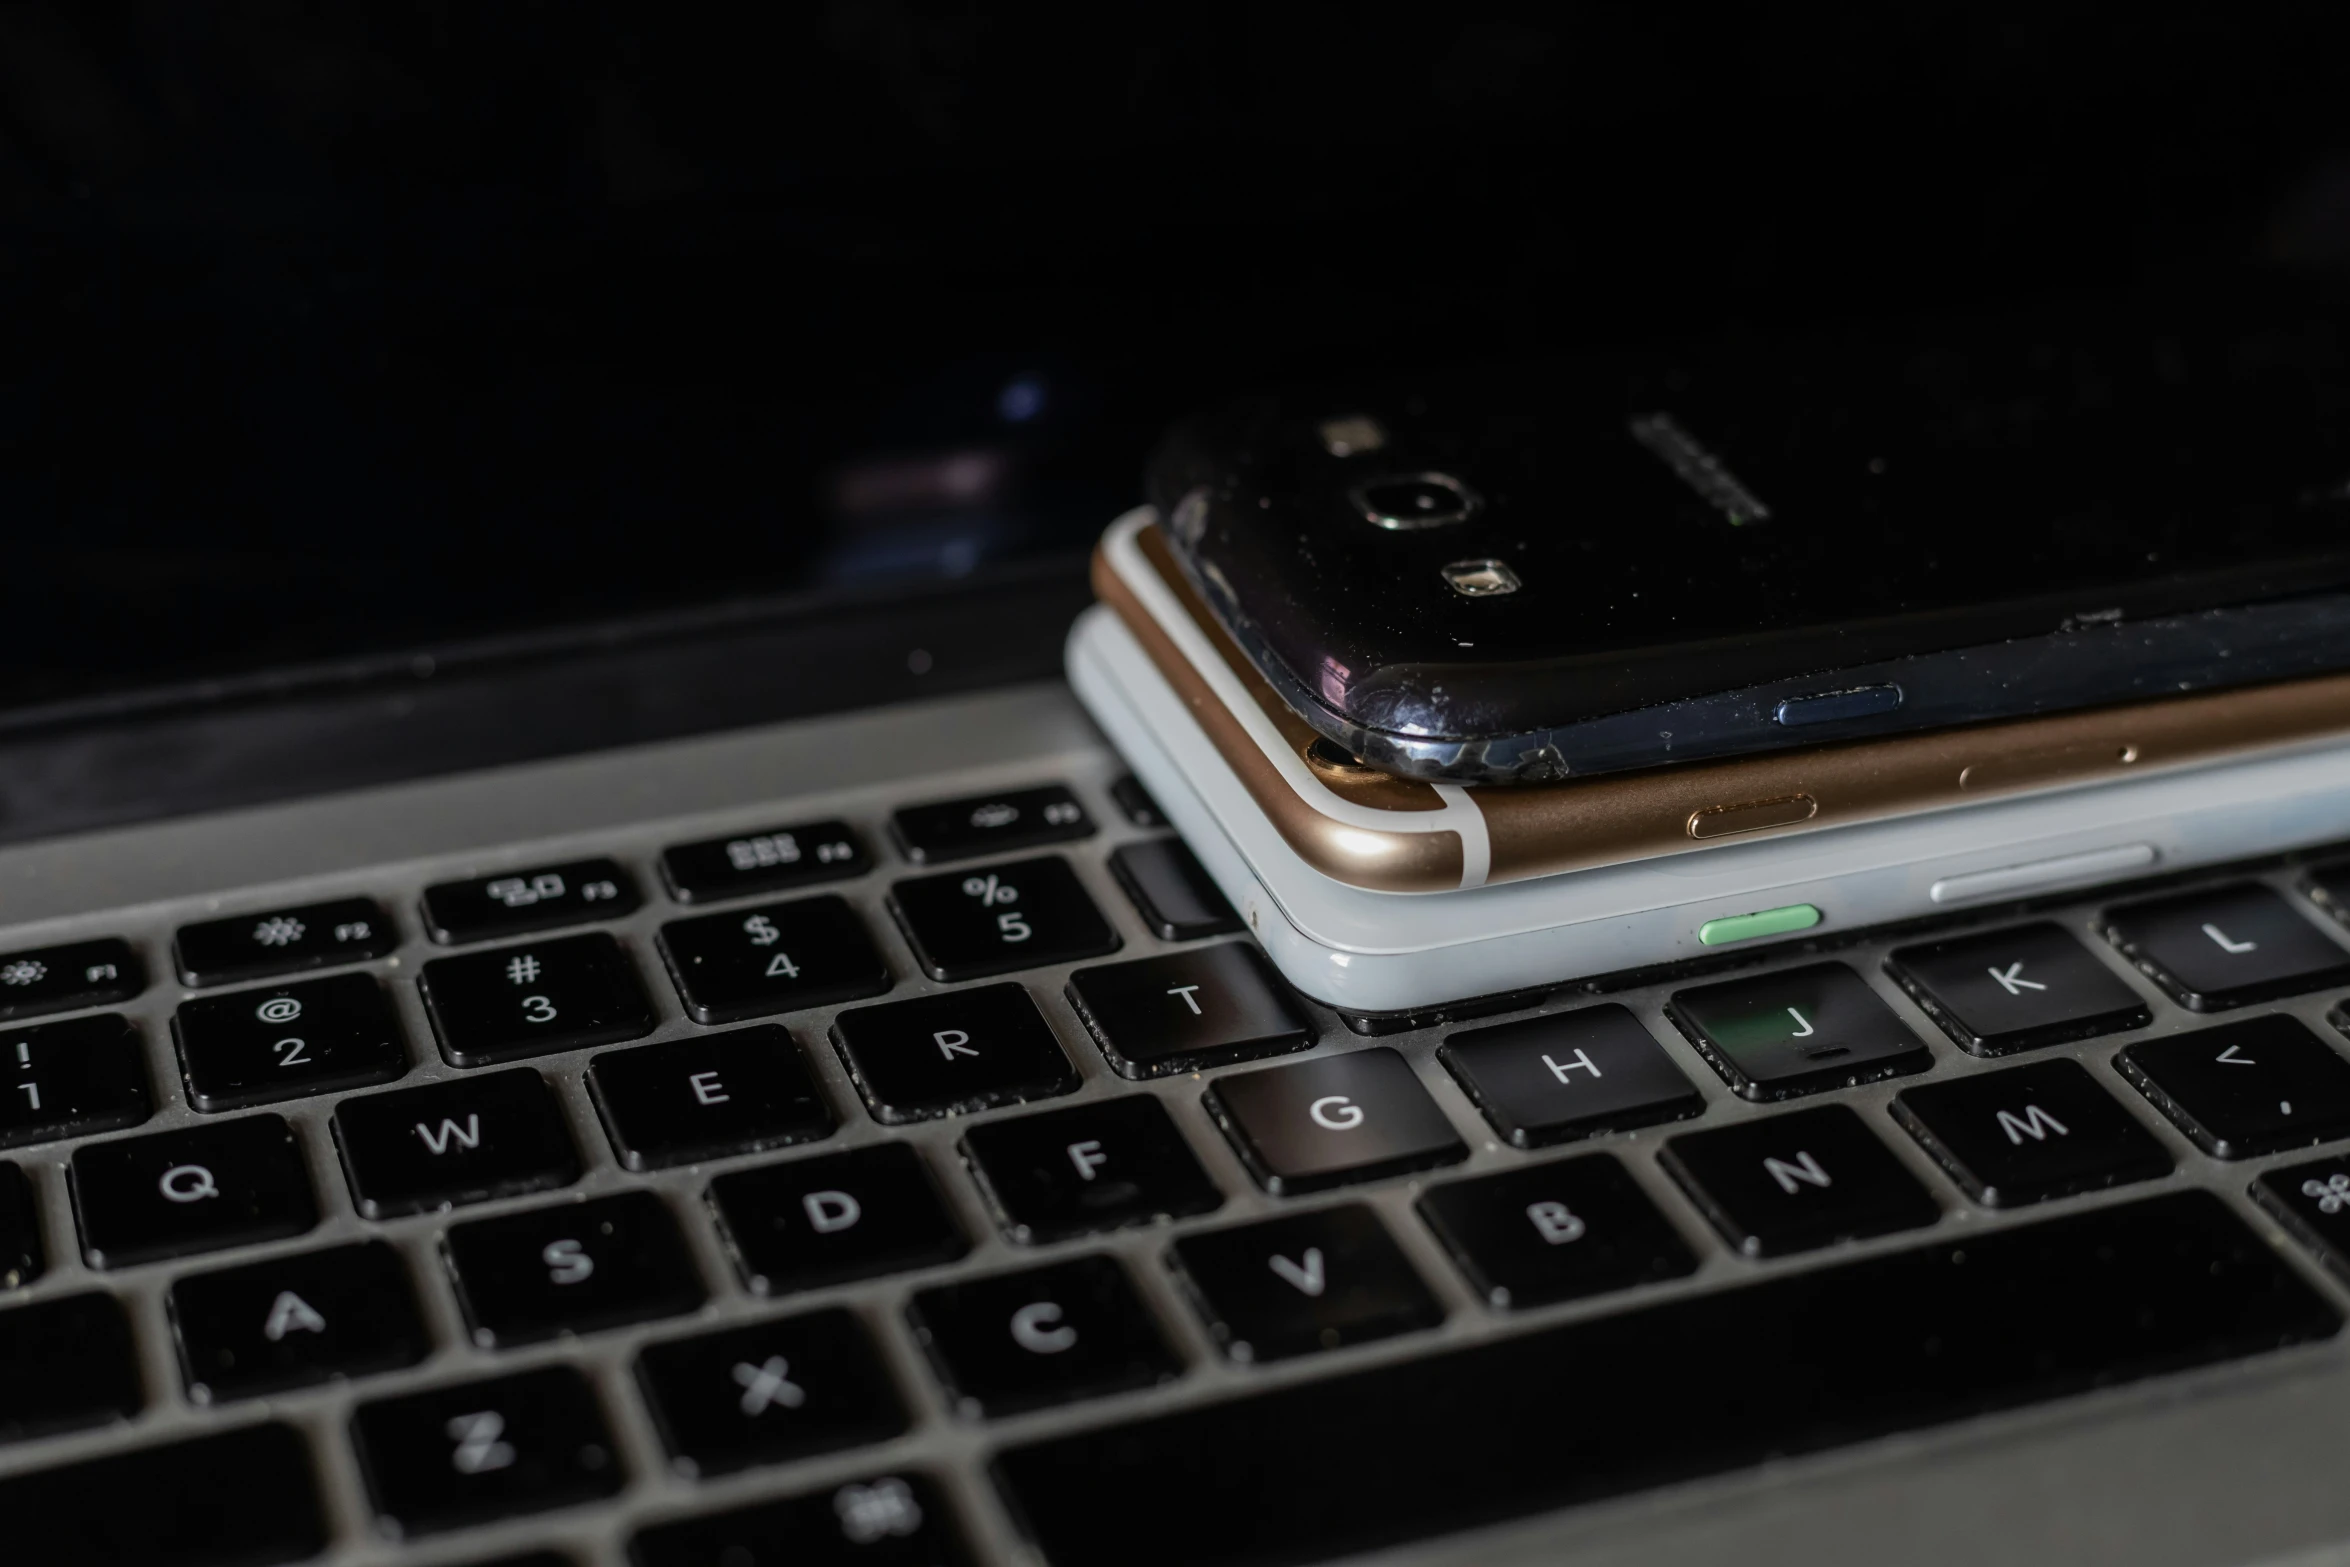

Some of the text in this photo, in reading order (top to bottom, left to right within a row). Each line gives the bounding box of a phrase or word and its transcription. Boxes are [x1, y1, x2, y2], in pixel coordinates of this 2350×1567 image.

[962, 874, 1019, 907] %
[335, 922, 371, 941] F2
[744, 915, 780, 945] $
[998, 912, 1032, 942] 5
[2202, 924, 2255, 953] L
[87, 964, 117, 982] F1
[507, 955, 541, 985] #
[765, 953, 800, 978] 4
[1988, 962, 2047, 996] K
[256, 997, 302, 1024] @
[522, 995, 558, 1023] 3
[1166, 984, 1202, 1015] T
[1787, 1007, 1815, 1038] J
[17, 1042, 32, 1069] !
[273, 1037, 312, 1067] 2
[933, 1029, 980, 1061] R
[2215, 1044, 2256, 1065] <
[1541, 1048, 1602, 1085] H
[17, 1082, 41, 1110] 1
[689, 1071, 730, 1105] E
[1310, 1095, 1364, 1131] G
[1996, 1105, 2068, 1145] M
[416, 1113, 480, 1154] W
[1068, 1140, 1106, 1180] F
[1764, 1151, 1830, 1194] N
[160, 1164, 219, 1202] Q
[803, 1190, 860, 1232] D
[1527, 1201, 1584, 1244] B
[544, 1239, 593, 1283] S
[1271, 1248, 1325, 1295] V
[266, 1291, 325, 1340] A
[1011, 1302, 1076, 1353] C
[731, 1354, 806, 1418] X
[444, 1409, 516, 1474] Z
